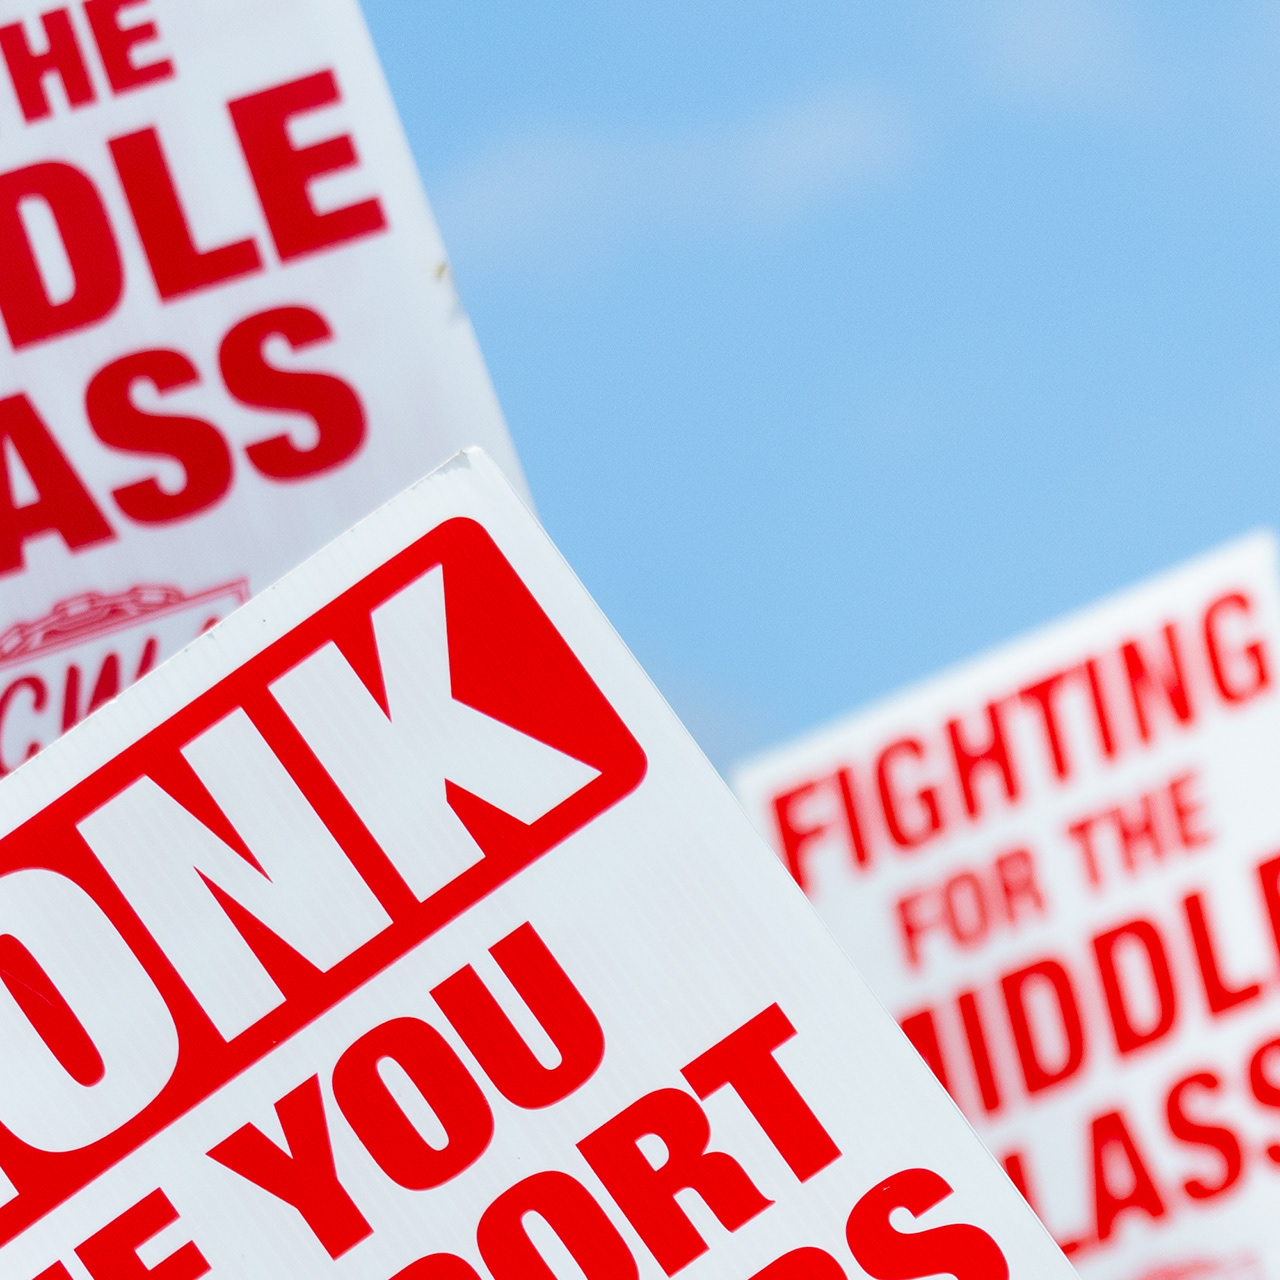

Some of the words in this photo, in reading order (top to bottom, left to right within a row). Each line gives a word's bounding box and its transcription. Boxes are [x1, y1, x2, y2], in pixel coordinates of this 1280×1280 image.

[0, 0, 174, 123] HE
[0, 67, 387, 350] DLE
[0, 305, 366, 576] ASS
[770, 591, 1272, 894] FIGHTING
[895, 847, 1045, 969] FOR
[1066, 773, 1212, 890] THE
[0, 563, 602, 1207] ONK
[206, 921, 605, 1260] YOU
